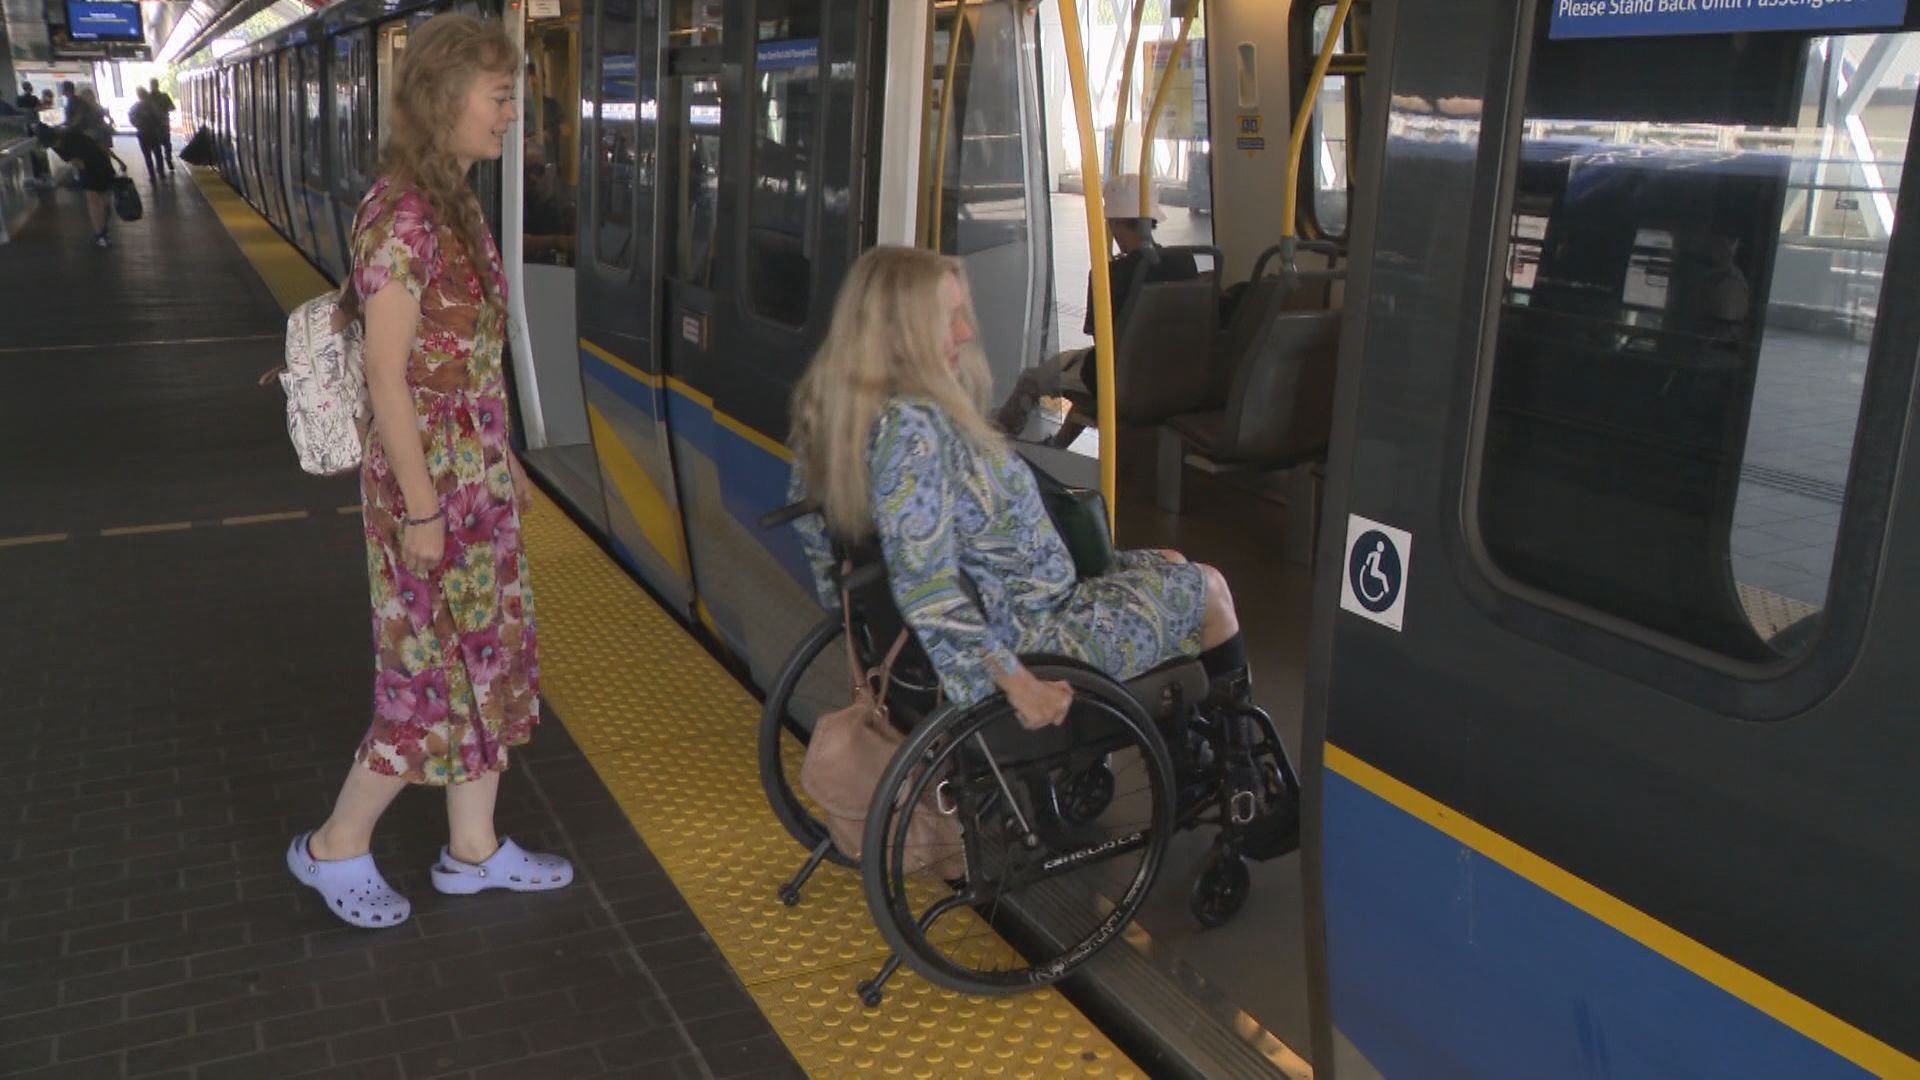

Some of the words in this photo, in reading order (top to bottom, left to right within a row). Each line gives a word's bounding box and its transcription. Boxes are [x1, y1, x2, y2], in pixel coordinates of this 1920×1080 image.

[1559, 0, 1606, 17] Please
[1609, 0, 1653, 15] Stand
[1658, 0, 1697, 12] Back
